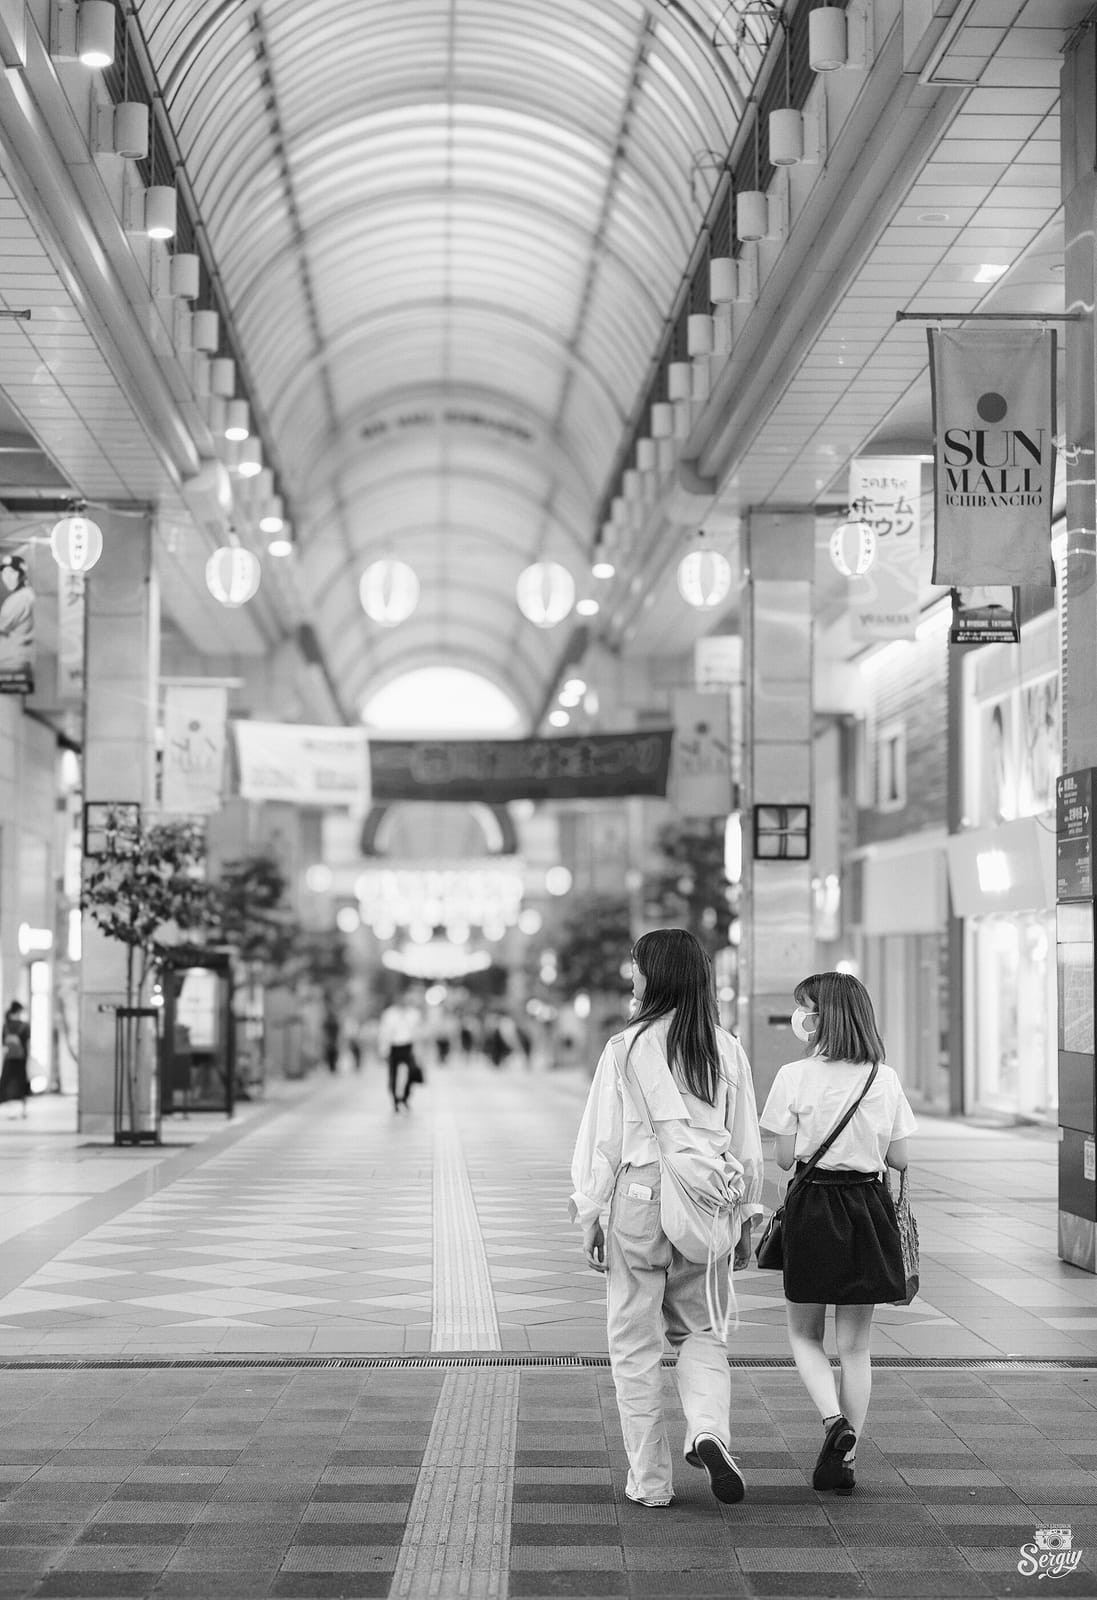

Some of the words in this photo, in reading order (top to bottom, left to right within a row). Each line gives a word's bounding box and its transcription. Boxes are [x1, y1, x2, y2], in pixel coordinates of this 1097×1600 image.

[944, 428, 1046, 468] SUN
[944, 467, 1042, 493] MALL
[853, 496, 914, 515] ホーム
[945, 494, 1042, 507] ICHIBANCHO
